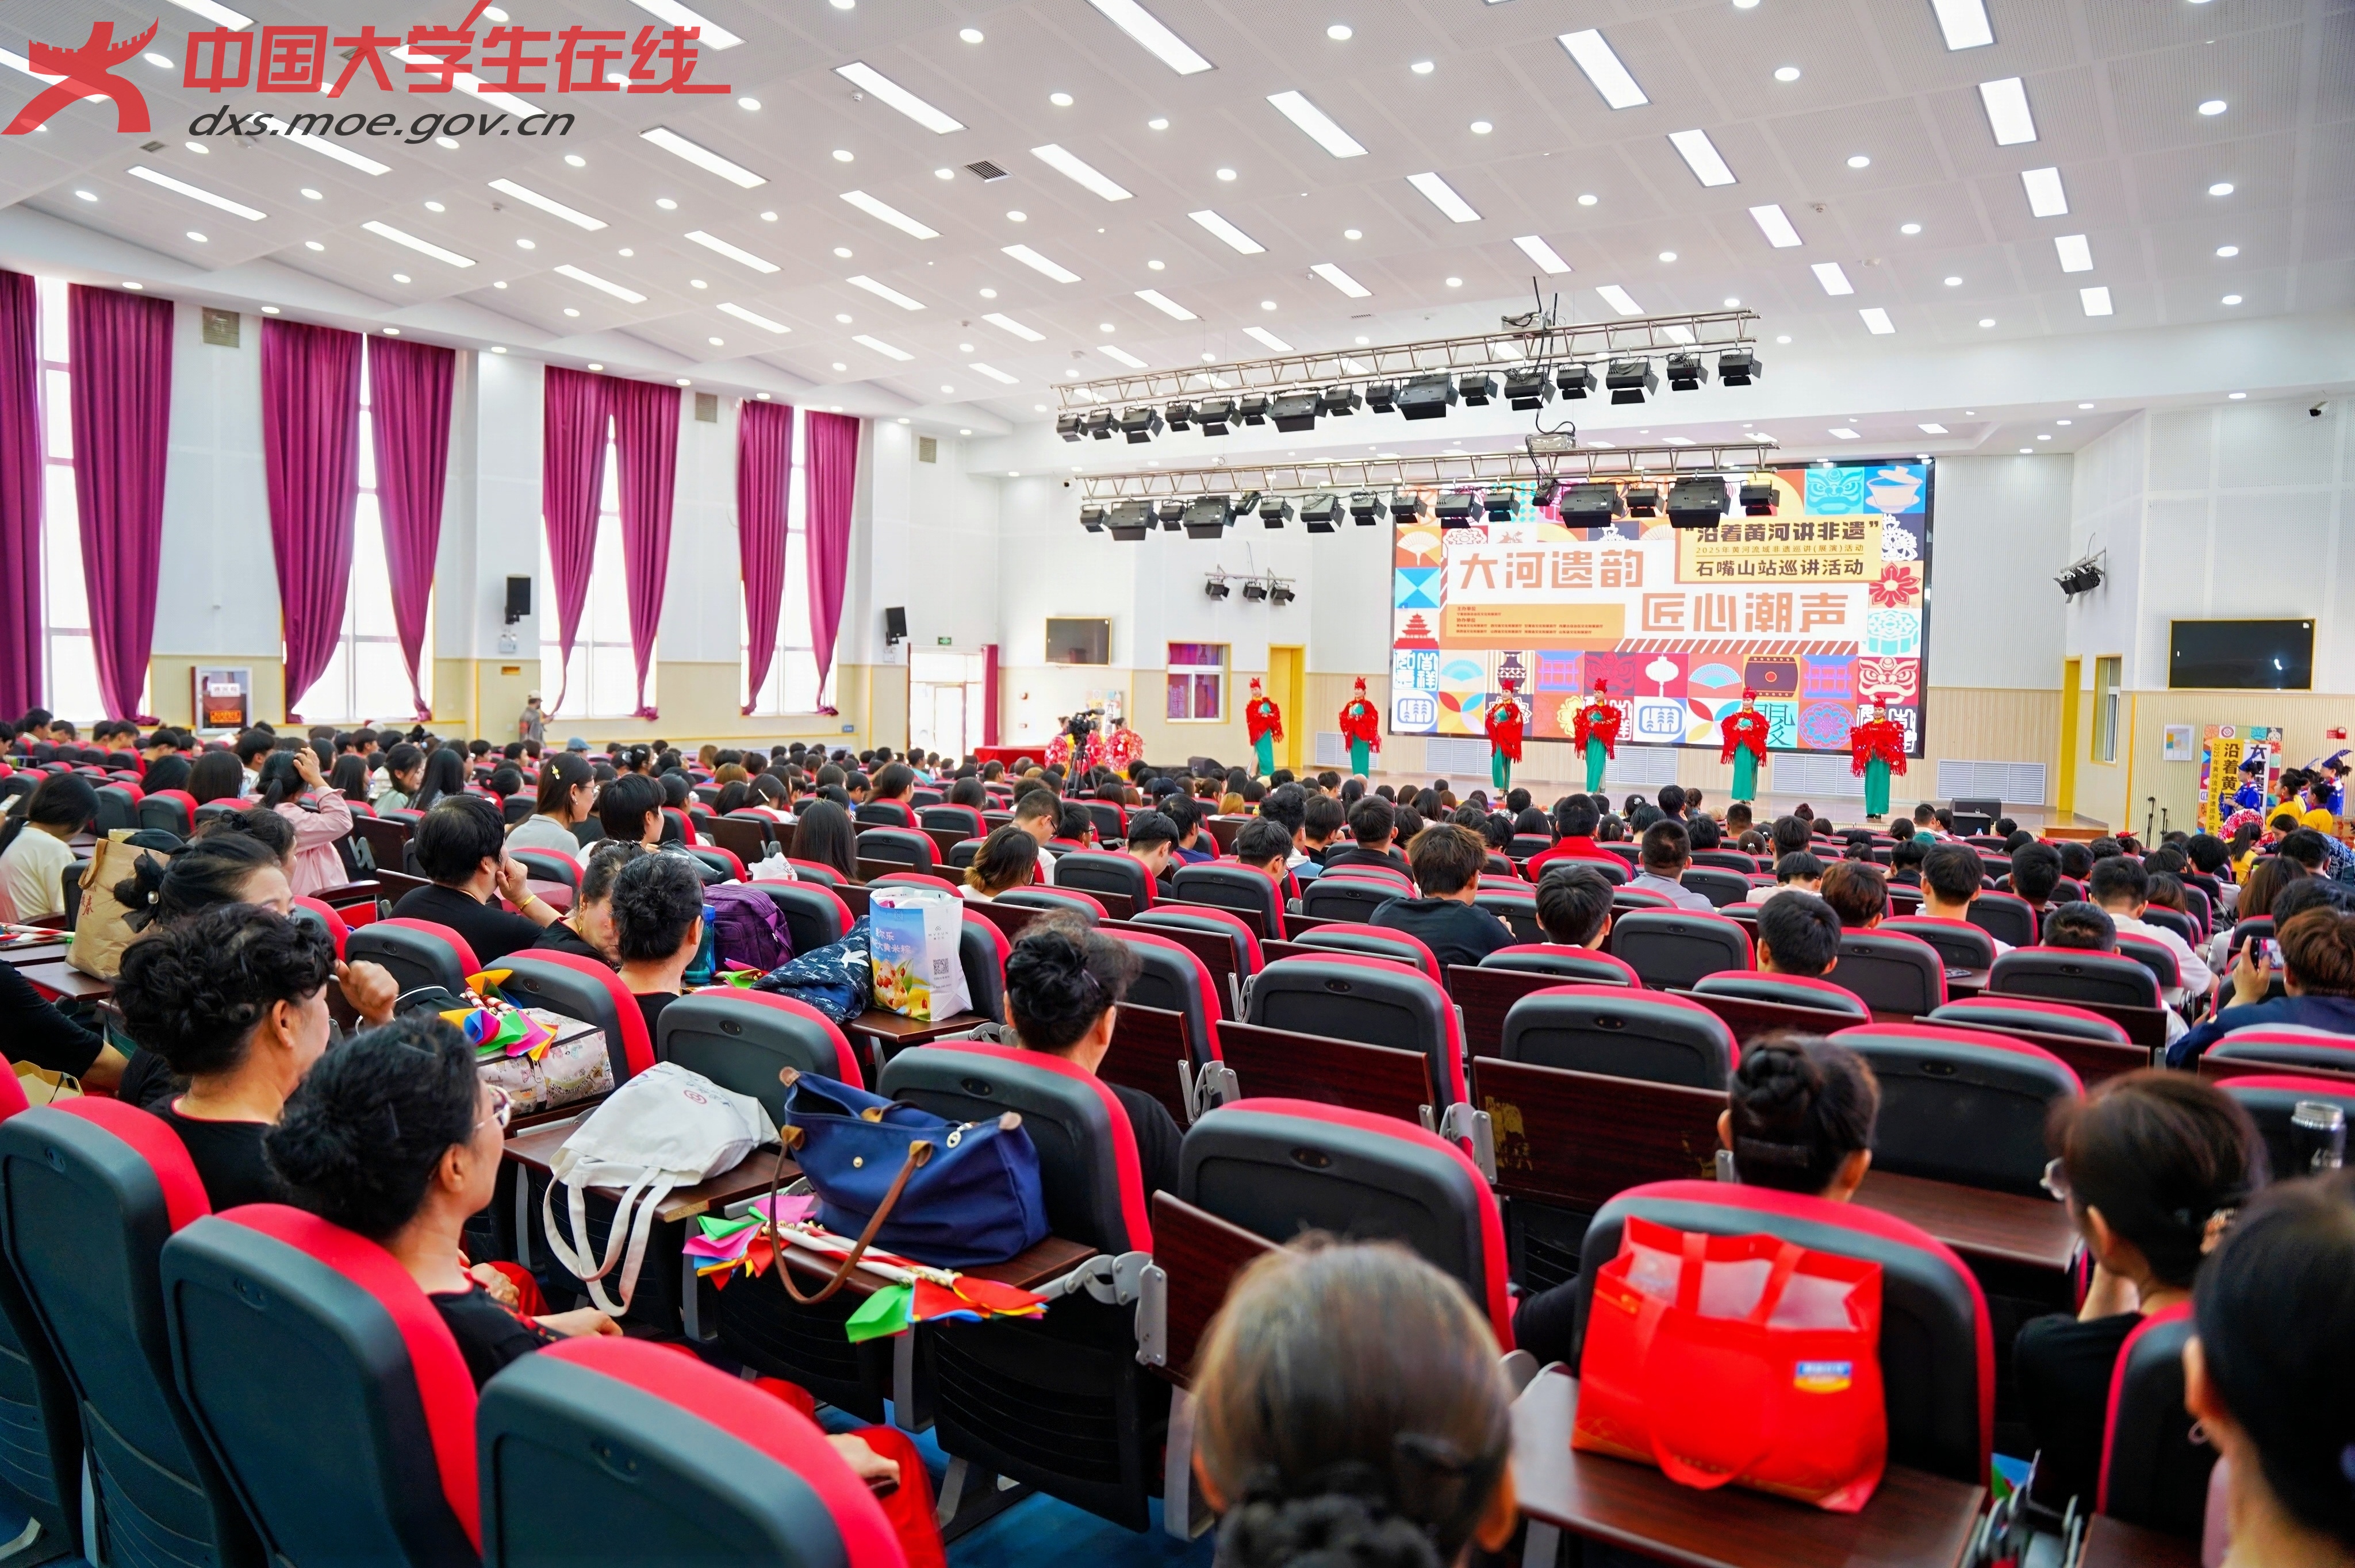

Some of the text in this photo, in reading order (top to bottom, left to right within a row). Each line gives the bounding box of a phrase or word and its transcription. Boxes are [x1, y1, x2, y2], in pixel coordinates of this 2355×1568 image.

[1460, 550, 1644, 589] 大河遗韵
[1696, 559, 1863, 577] 石嘴山站巡讲活动
[1642, 593, 1848, 633] 匠心潮声
